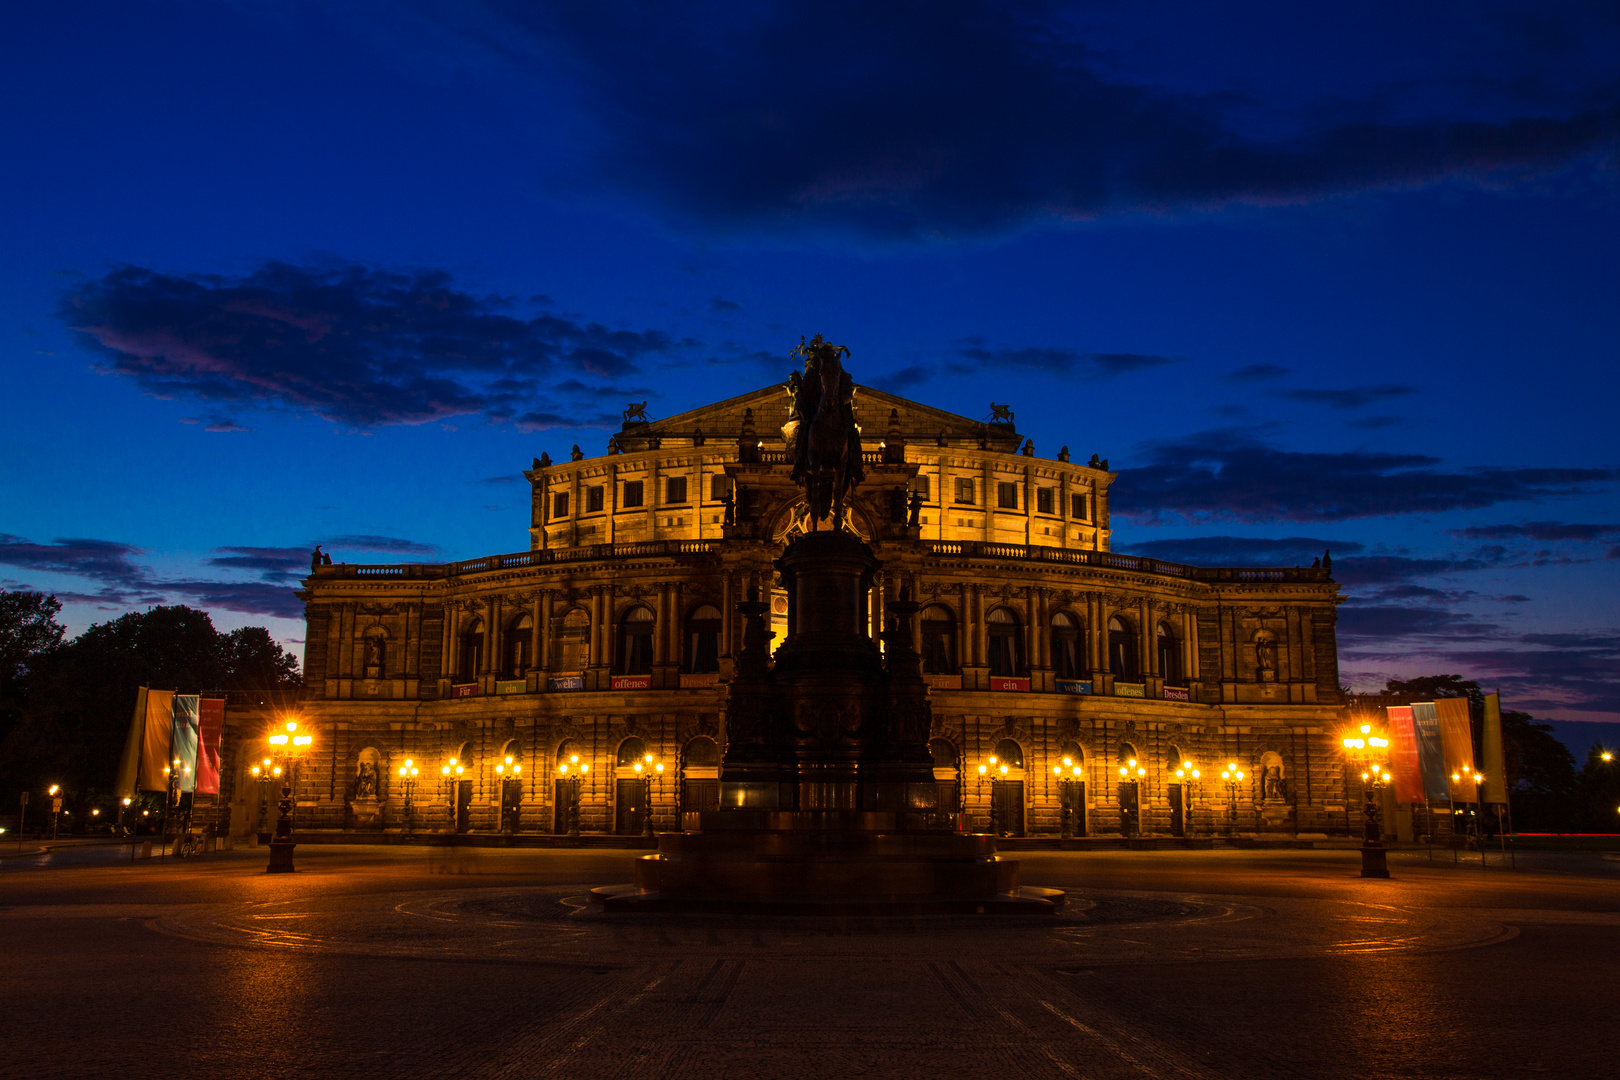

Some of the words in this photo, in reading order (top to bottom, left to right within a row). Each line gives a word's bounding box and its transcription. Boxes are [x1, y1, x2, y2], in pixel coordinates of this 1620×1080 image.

[505, 684, 517, 693] ein
[555, 679, 576, 689] welt-
[614, 679, 648, 688] offenes
[1003, 680, 1018, 690] ein
[1064, 683, 1085, 693] welt-
[459, 687, 470, 696] Für
[1117, 686, 1143, 697] offenes
[1164, 689, 1190, 701] Dresden
